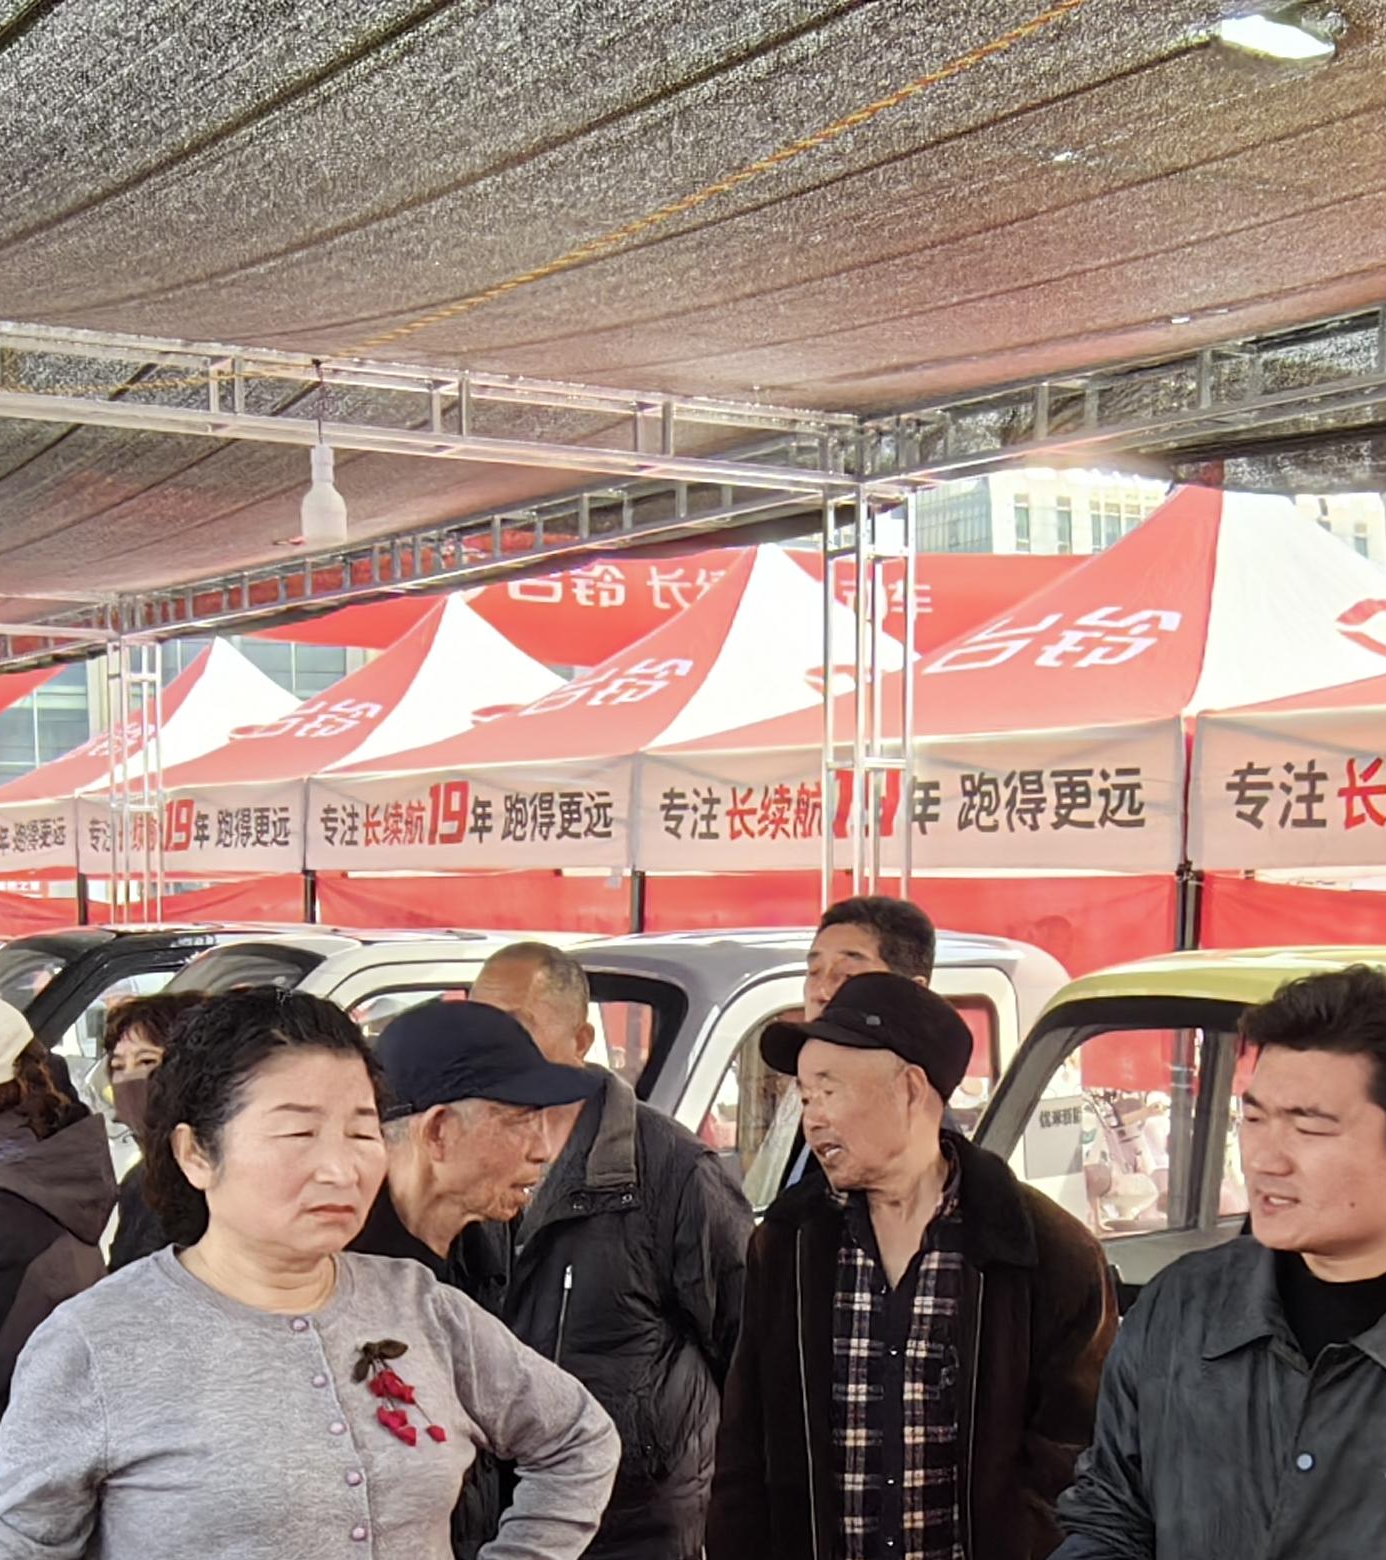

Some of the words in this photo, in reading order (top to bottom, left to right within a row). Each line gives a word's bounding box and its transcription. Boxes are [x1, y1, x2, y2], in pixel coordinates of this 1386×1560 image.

[922, 605, 1181, 670] 台铃
[216, 807, 290, 848] 跑得更远
[320, 780, 492, 846] 专注长续航19年
[501, 791, 613, 841] 跑得更远
[957, 768, 1146, 832] 跑得更远
